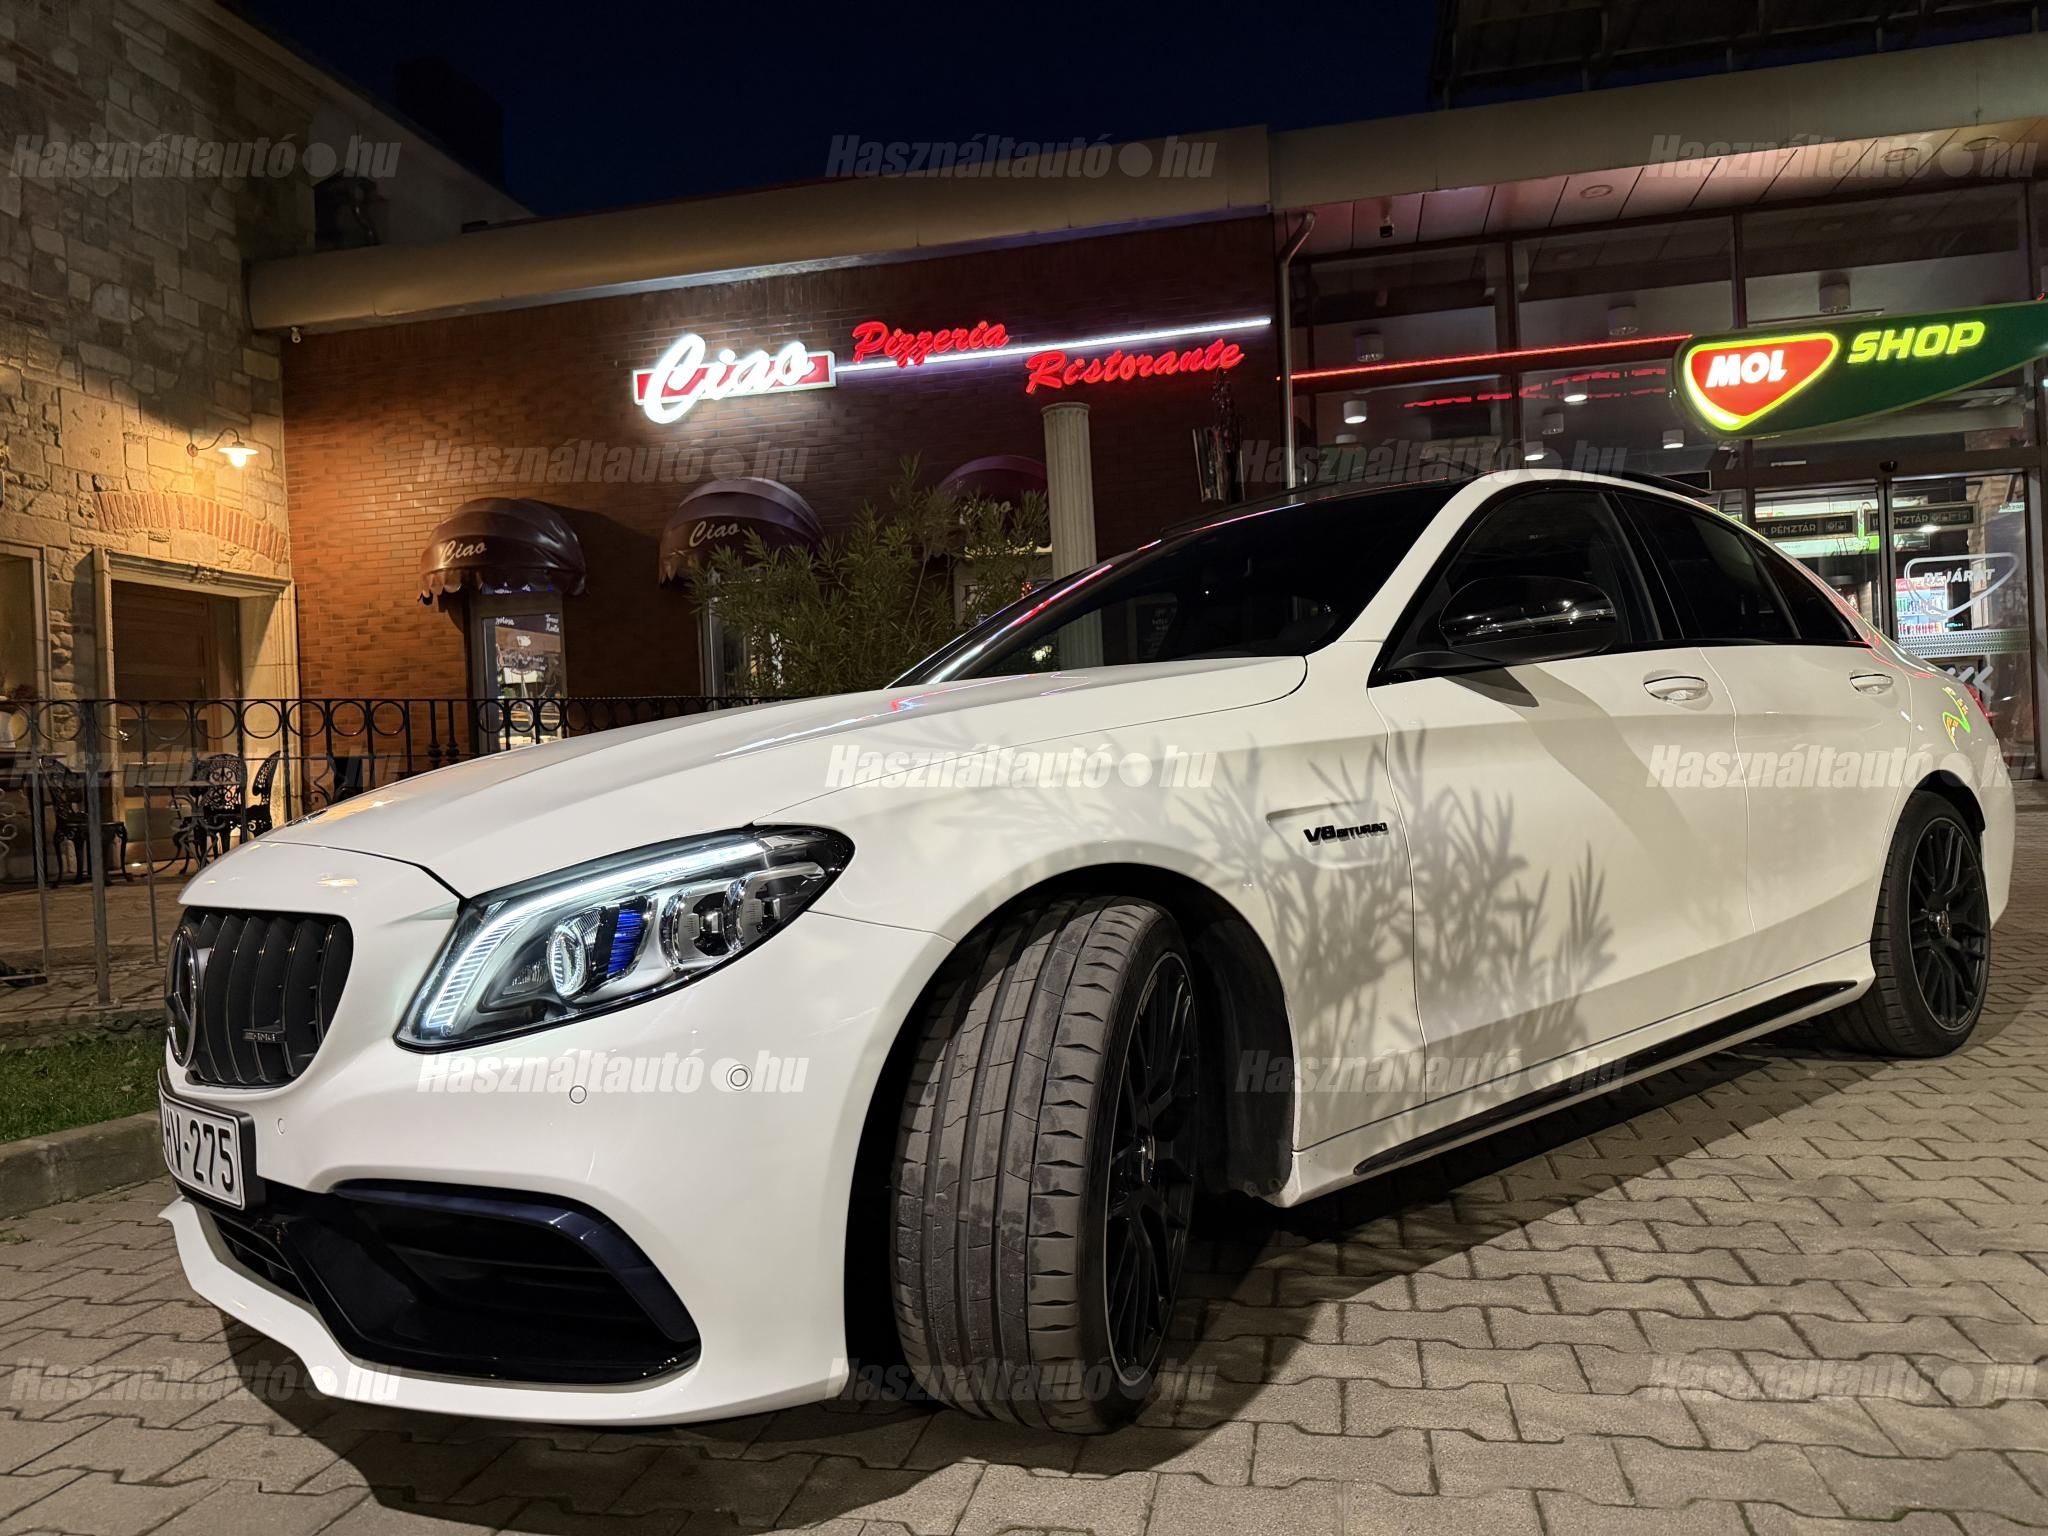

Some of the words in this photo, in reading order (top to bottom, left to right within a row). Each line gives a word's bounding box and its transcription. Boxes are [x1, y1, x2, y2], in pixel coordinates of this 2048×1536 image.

[851, 321, 1010, 368] Pizzeria
[1705, 350, 1788, 388] MOL
[1848, 321, 1985, 363] SHOP
[643, 332, 816, 425] Ciao
[1025, 338, 1246, 394] Ristorante
[689, 520, 741, 548] Ciao
[1895, 513, 1928, 524] NZTÁR
[440, 539, 488, 565] Ciao
[1303, 824, 1337, 844] V8
